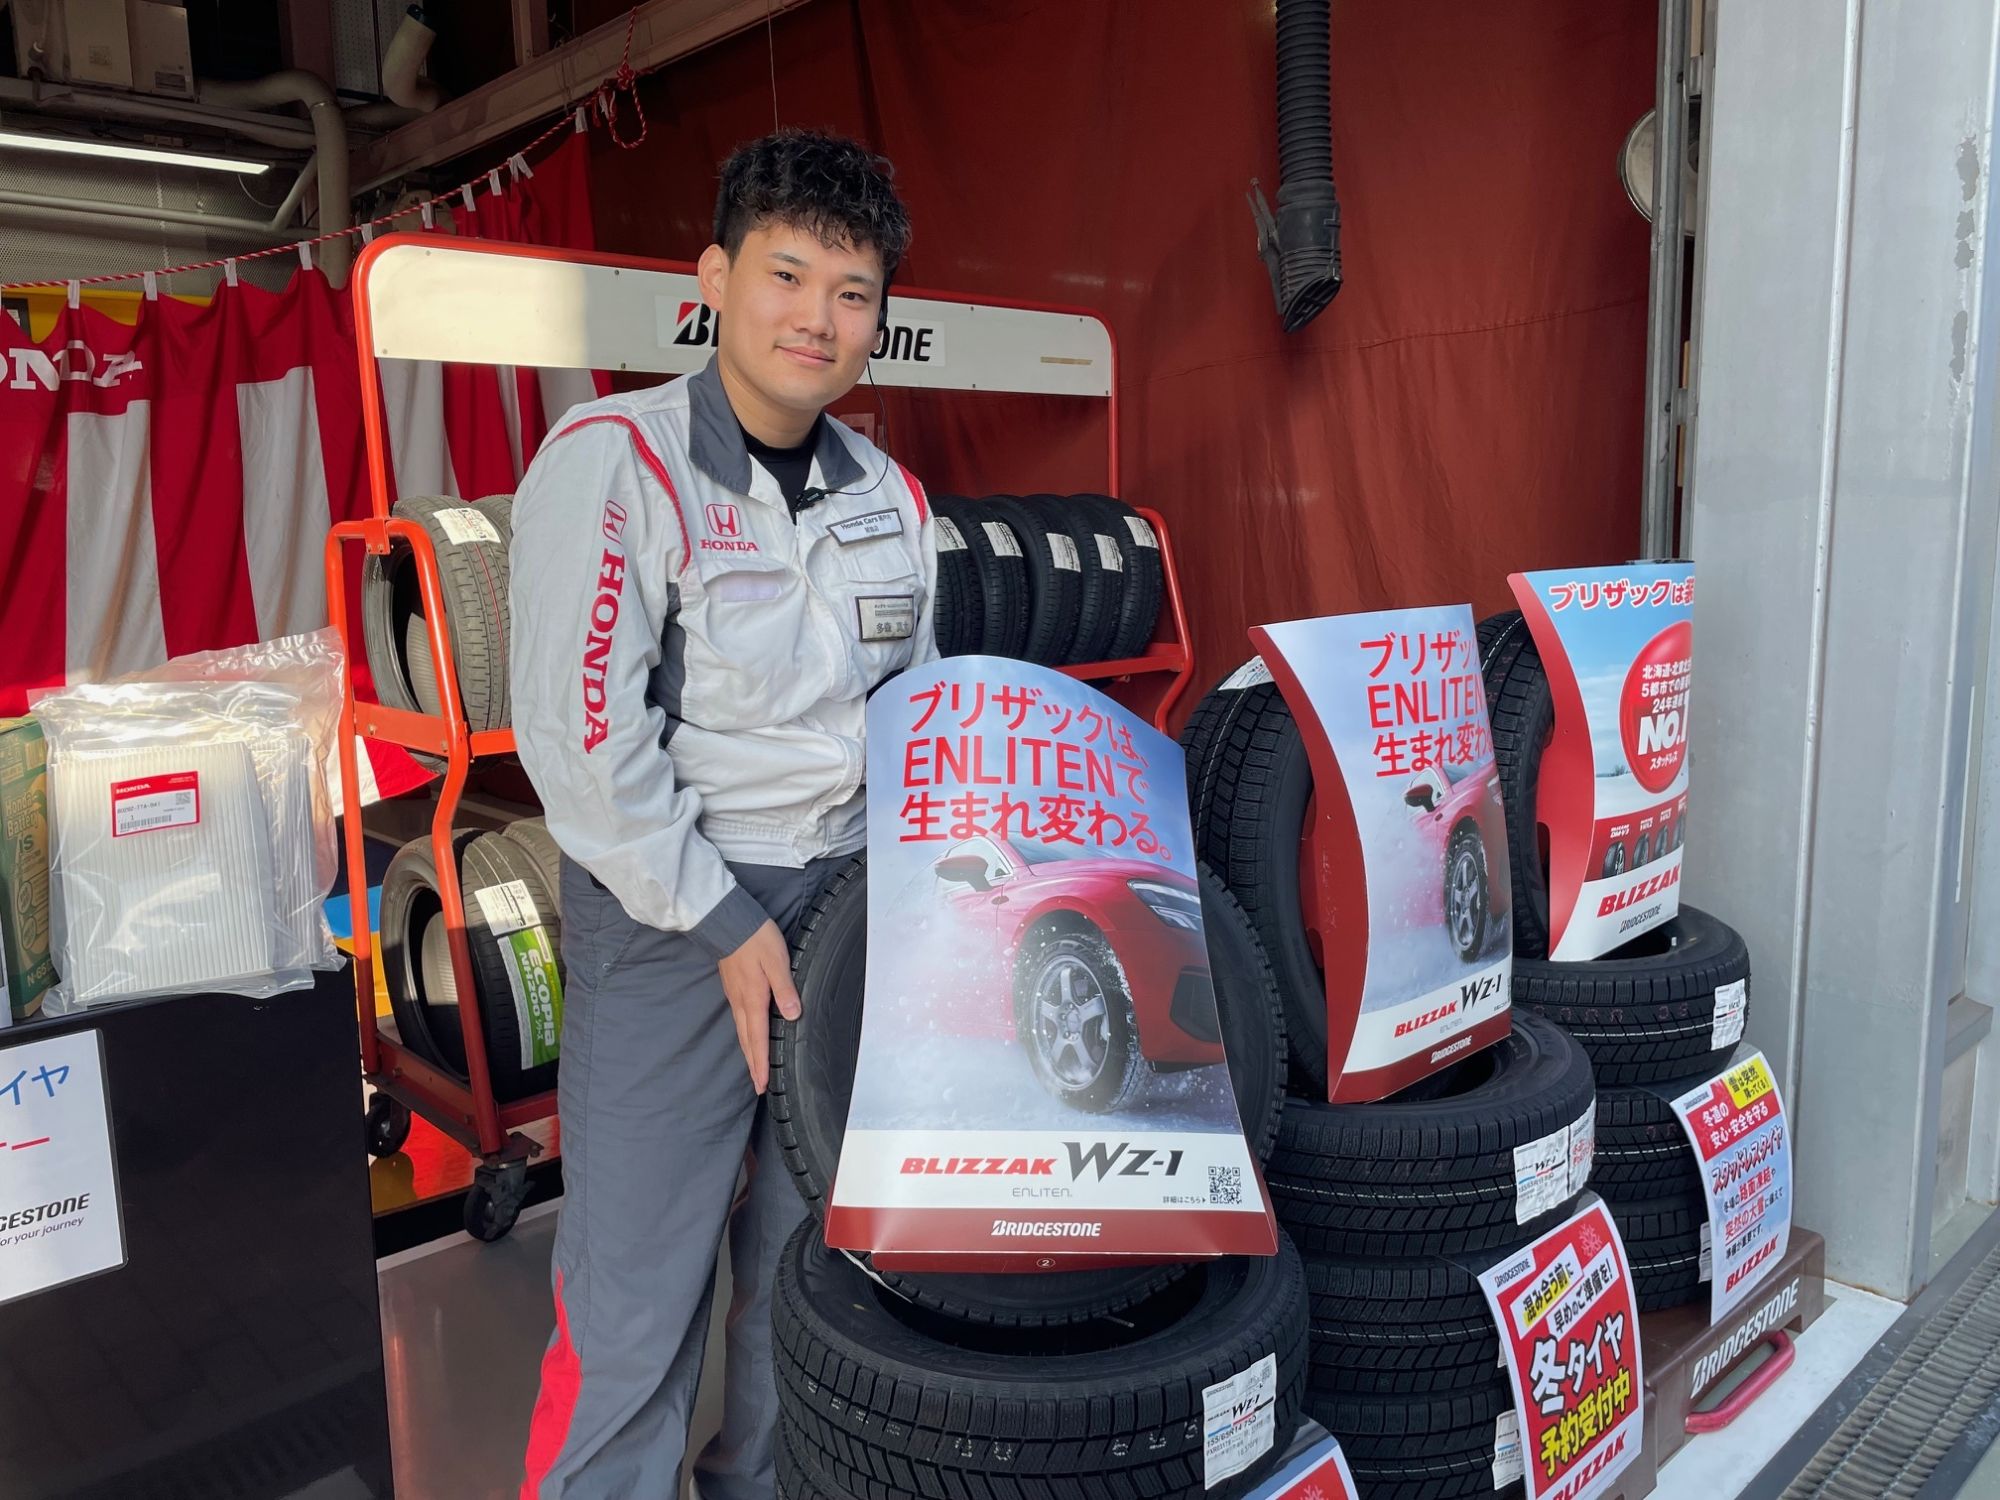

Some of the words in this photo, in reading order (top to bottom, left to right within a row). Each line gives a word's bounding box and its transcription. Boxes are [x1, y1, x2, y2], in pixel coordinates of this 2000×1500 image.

[700, 539, 758, 551] HONDA
[840, 520, 864, 532] Honda
[583, 548, 625, 755] HONDA
[1360, 631, 1479, 678] ブリザッ
[909, 680, 1149, 768] ブリザックは、
[116, 783, 151, 794] HONDA
[899, 791, 1172, 861] 生まれ変わる。
[1597, 864, 1681, 918] BLIZZAK
[520, 952, 541, 1017] NH200
[1394, 1000, 1457, 1038] BLIZZAK
[1460, 973, 1502, 1012] WZ-1
[1702, 1102, 1729, 1127] 冬道の
[900, 1157, 1058, 1175] BLIZZAK
[1061, 1141, 1184, 1183] WZ-1
[1712, 1124, 1783, 1196] スタッドレスタイヤ
[15, 1229, 41, 1245] your
[41, 1217, 84, 1238] journey
[991, 1219, 1101, 1237] BRIDGESTONE
[1494, 1258, 1531, 1289] BRIDGESTONE
[1725, 1233, 1779, 1293] BLIZZAK
[1523, 1262, 1574, 1324] 混み合う前に
[1528, 1310, 1626, 1415] 冬タイヤ
[1690, 1277, 1800, 1400] BRIDGESTONE
[1231, 1394, 1261, 1419] WZ-1
[1540, 1366, 1632, 1478] 予約受付中
